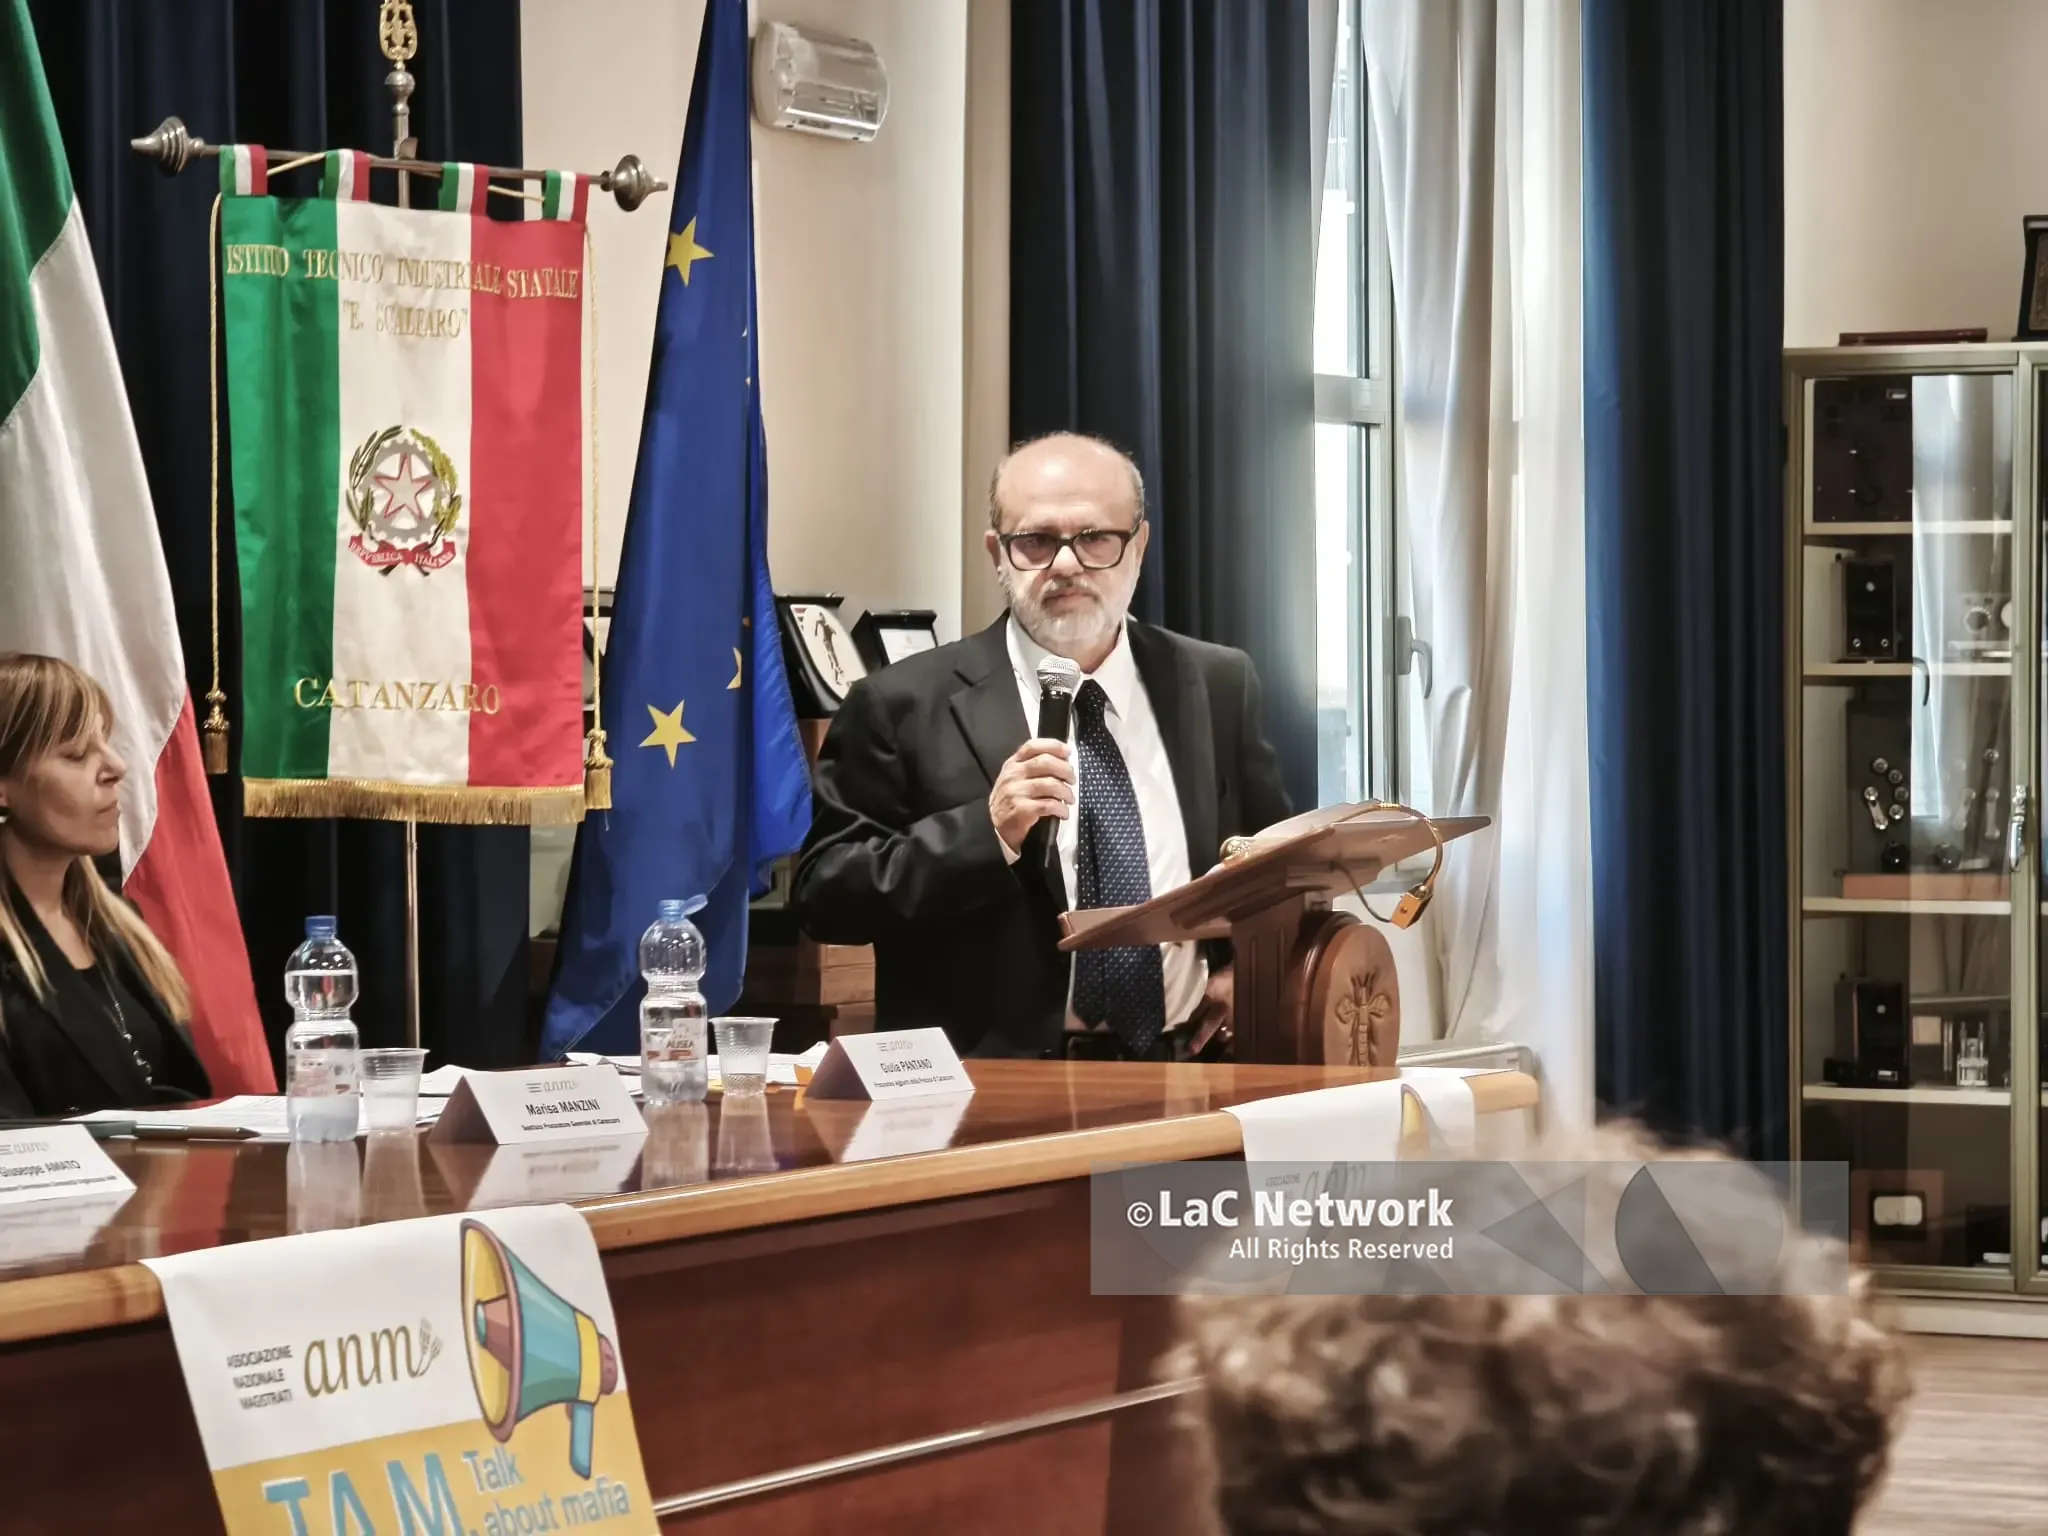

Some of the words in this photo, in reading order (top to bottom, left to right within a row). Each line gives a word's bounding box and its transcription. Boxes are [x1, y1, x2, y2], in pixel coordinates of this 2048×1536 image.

[303, 249, 384, 284] TECNICO
[396, 258, 501, 295] INDUSTRIALE
[507, 267, 580, 299] STATALE
[294, 677, 500, 715] CATANZARO
[900, 1058, 932, 1072] PANTANO
[525, 1103, 559, 1116] Marisa
[558, 1098, 600, 1112] MANZINI
[45, 1160, 81, 1172] AMATO
[303, 1325, 419, 1398] anm
[232, 1368, 285, 1389] NAZIONALE
[239, 1389, 293, 1410] MAGISTRATI
[462, 1445, 525, 1495] Talk
[483, 1493, 561, 1536] about
[561, 1474, 631, 1527] mafia
